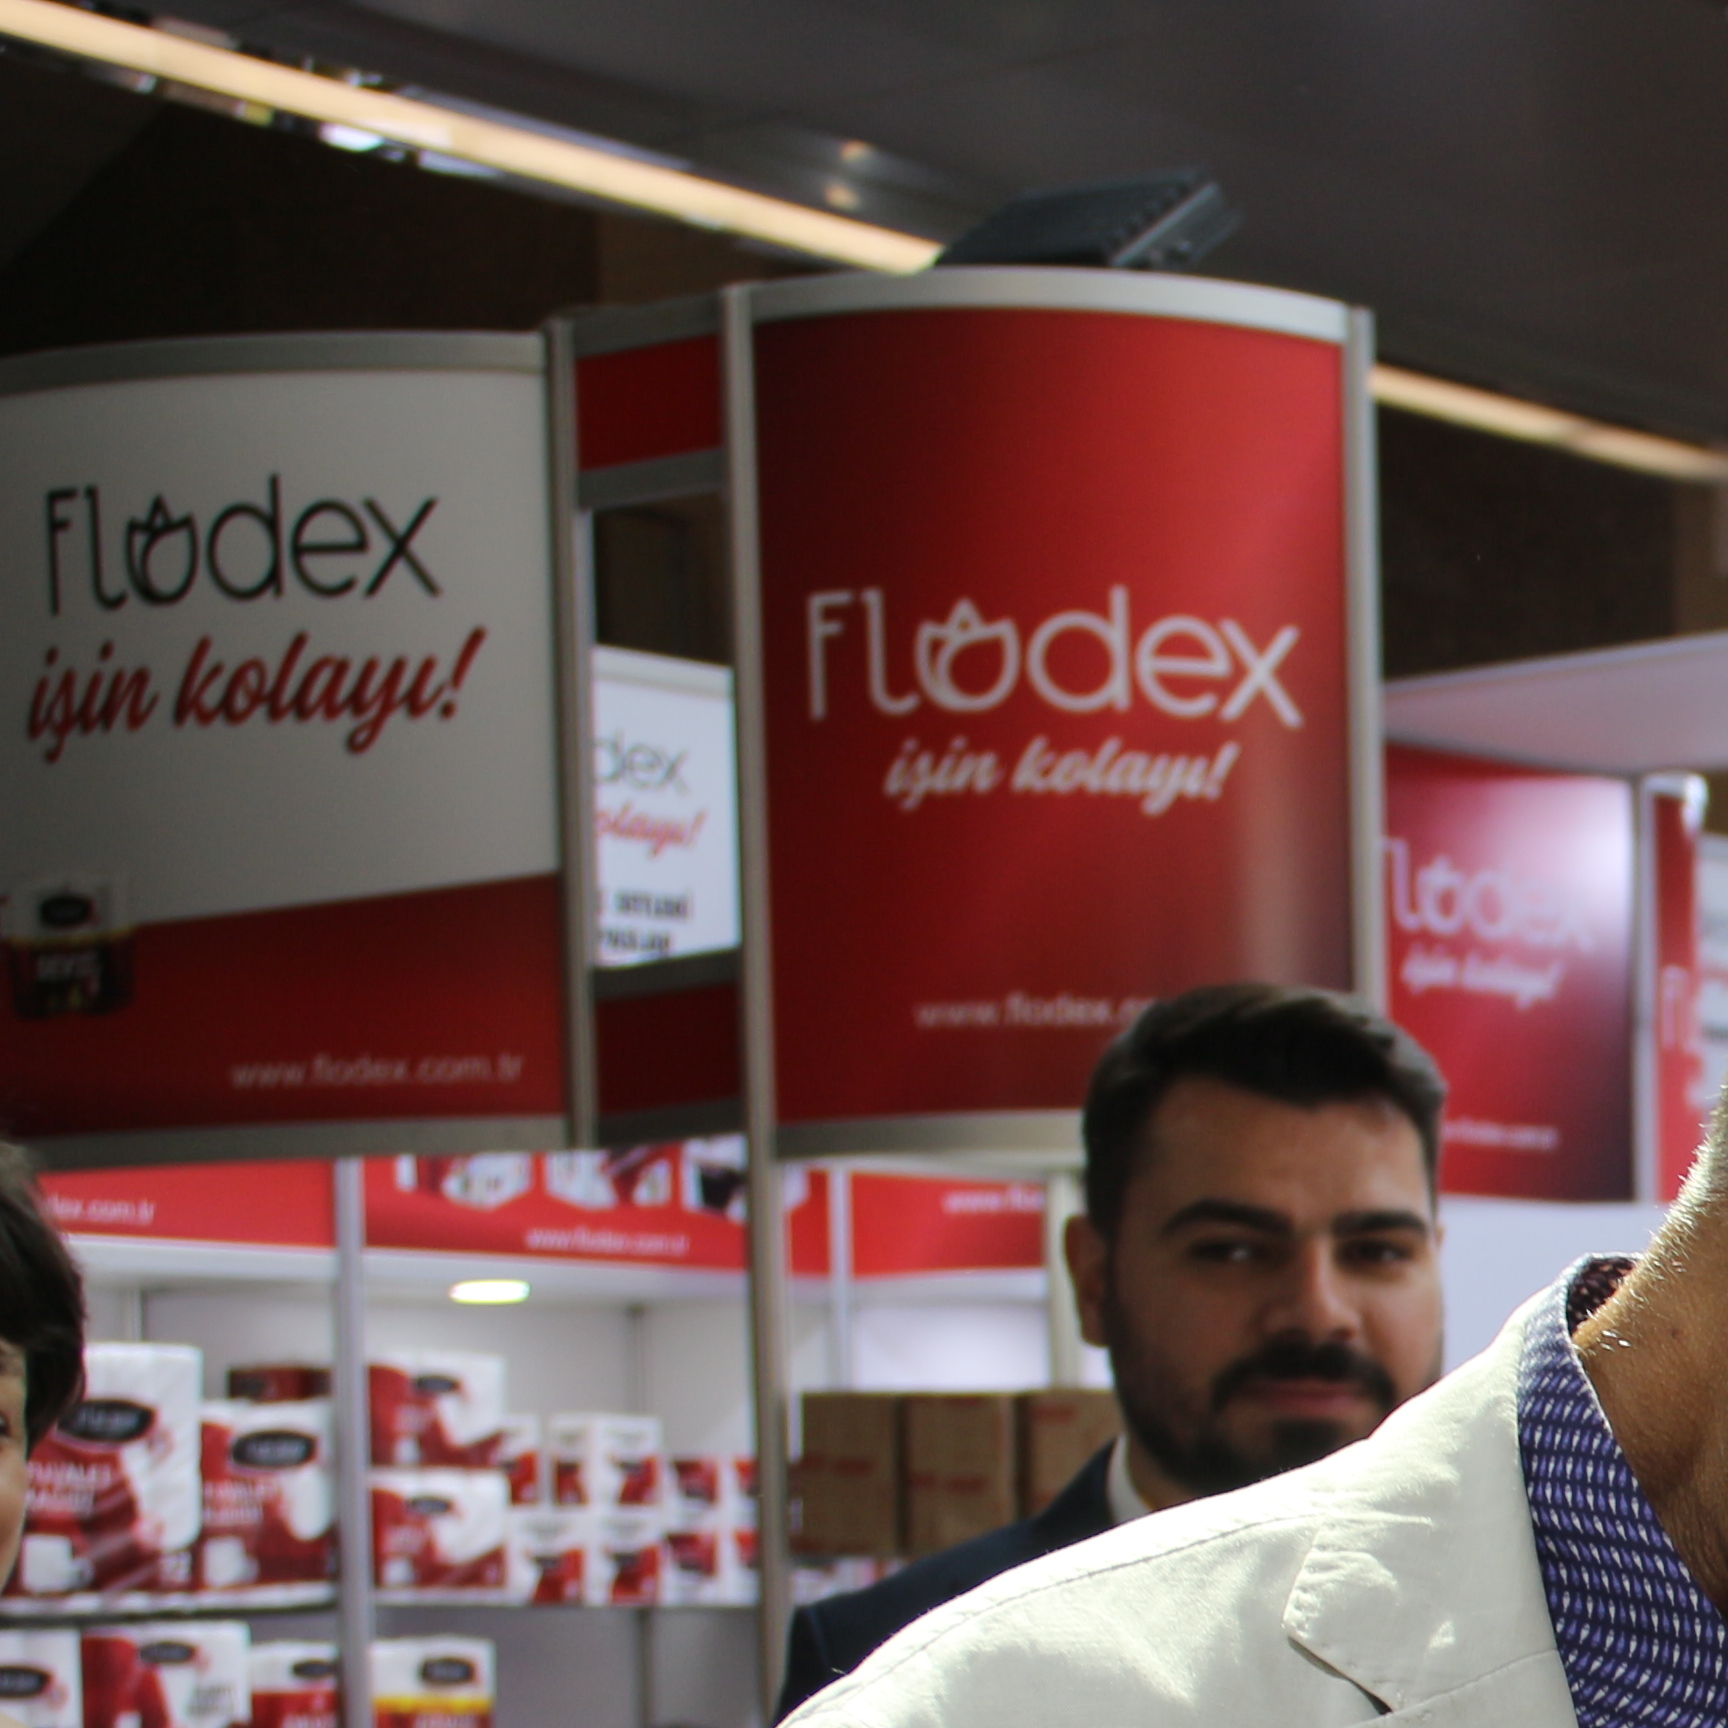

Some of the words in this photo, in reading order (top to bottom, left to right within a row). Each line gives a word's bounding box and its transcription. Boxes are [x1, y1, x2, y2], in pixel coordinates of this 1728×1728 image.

[46, 473, 441, 616] Flodex
[27, 640, 160, 764] işin
[173, 624, 488, 755] kolayı!
[808, 583, 1304, 729] Flodex
[884, 735, 1003, 812] işin
[1011, 735, 1242, 817] kolayı!
